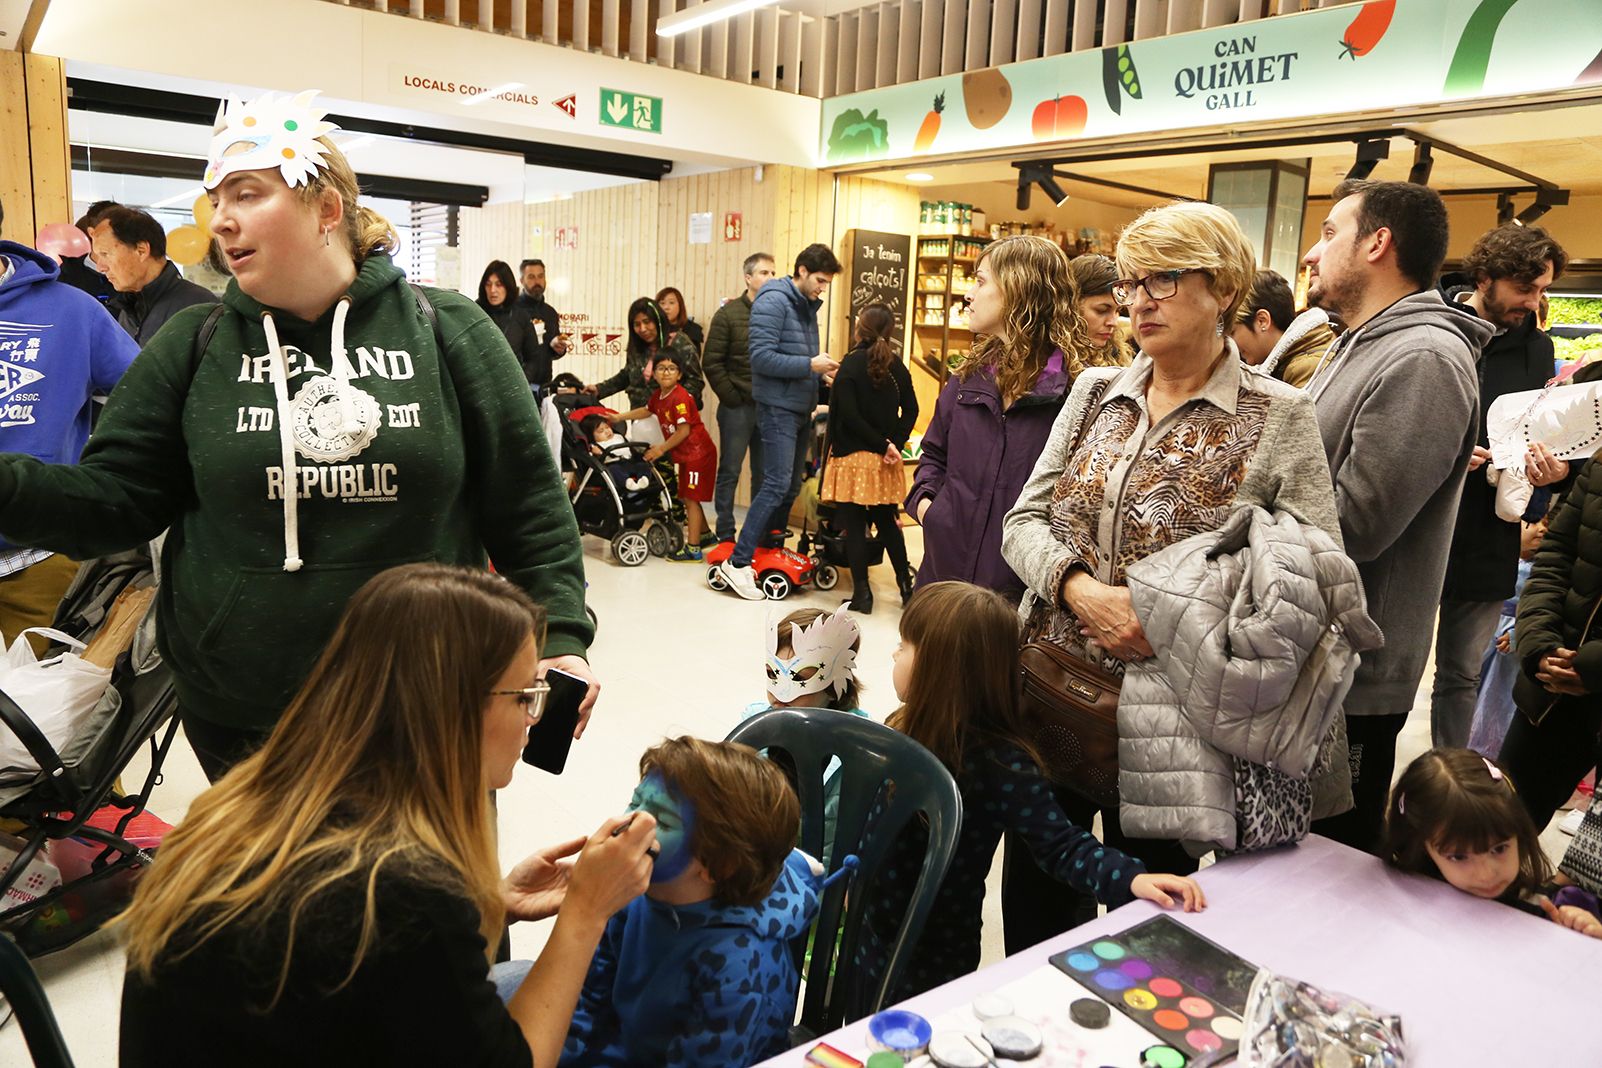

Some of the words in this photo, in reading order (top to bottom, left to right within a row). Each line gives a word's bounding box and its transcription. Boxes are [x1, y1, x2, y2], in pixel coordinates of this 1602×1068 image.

[1214, 36, 1257, 58] CAN
[404, 75, 455, 93] LOCALS
[1205, 90, 1257, 110] GALL
[863, 245, 875, 259] Ja
[877, 243, 902, 263] tenim
[860, 265, 905, 291] calçots!
[8, 393, 40, 402] ASSOC.
[236, 407, 275, 433] LTD
[386, 403, 421, 428] EDT
[688, 470, 699, 486] 11
